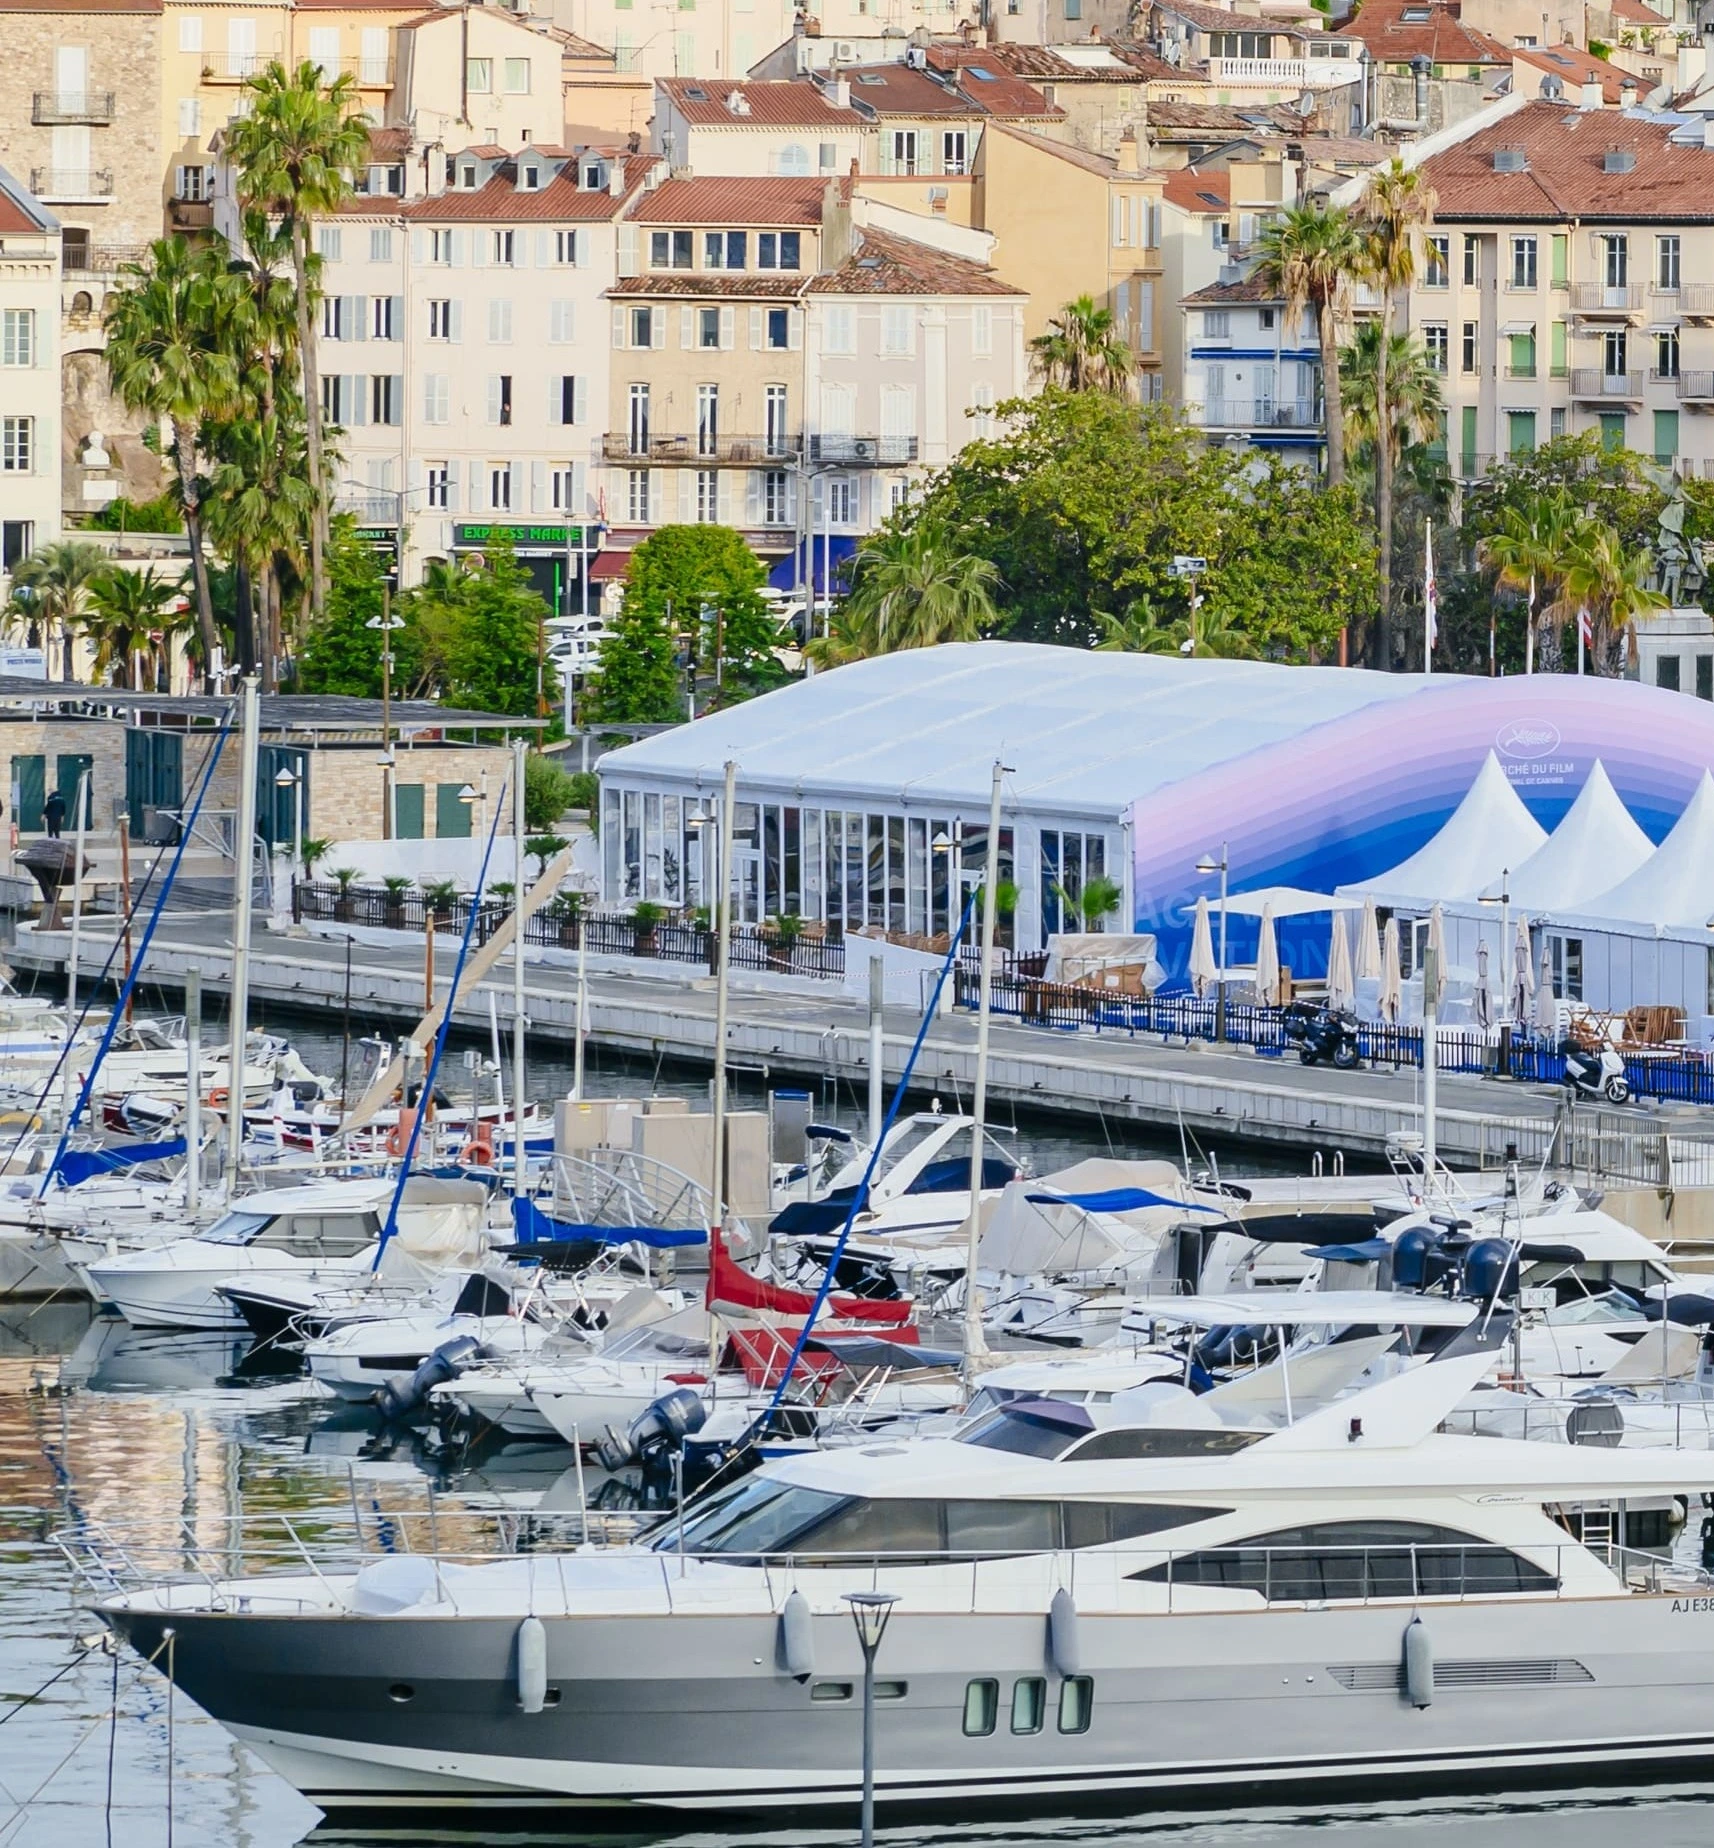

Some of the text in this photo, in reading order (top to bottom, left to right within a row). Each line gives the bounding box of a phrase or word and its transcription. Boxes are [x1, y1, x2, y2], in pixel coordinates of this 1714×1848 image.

[463, 526, 526, 540] EXPESS
[1532, 763, 1547, 775] DU
[1549, 763, 1575, 774] FILM
